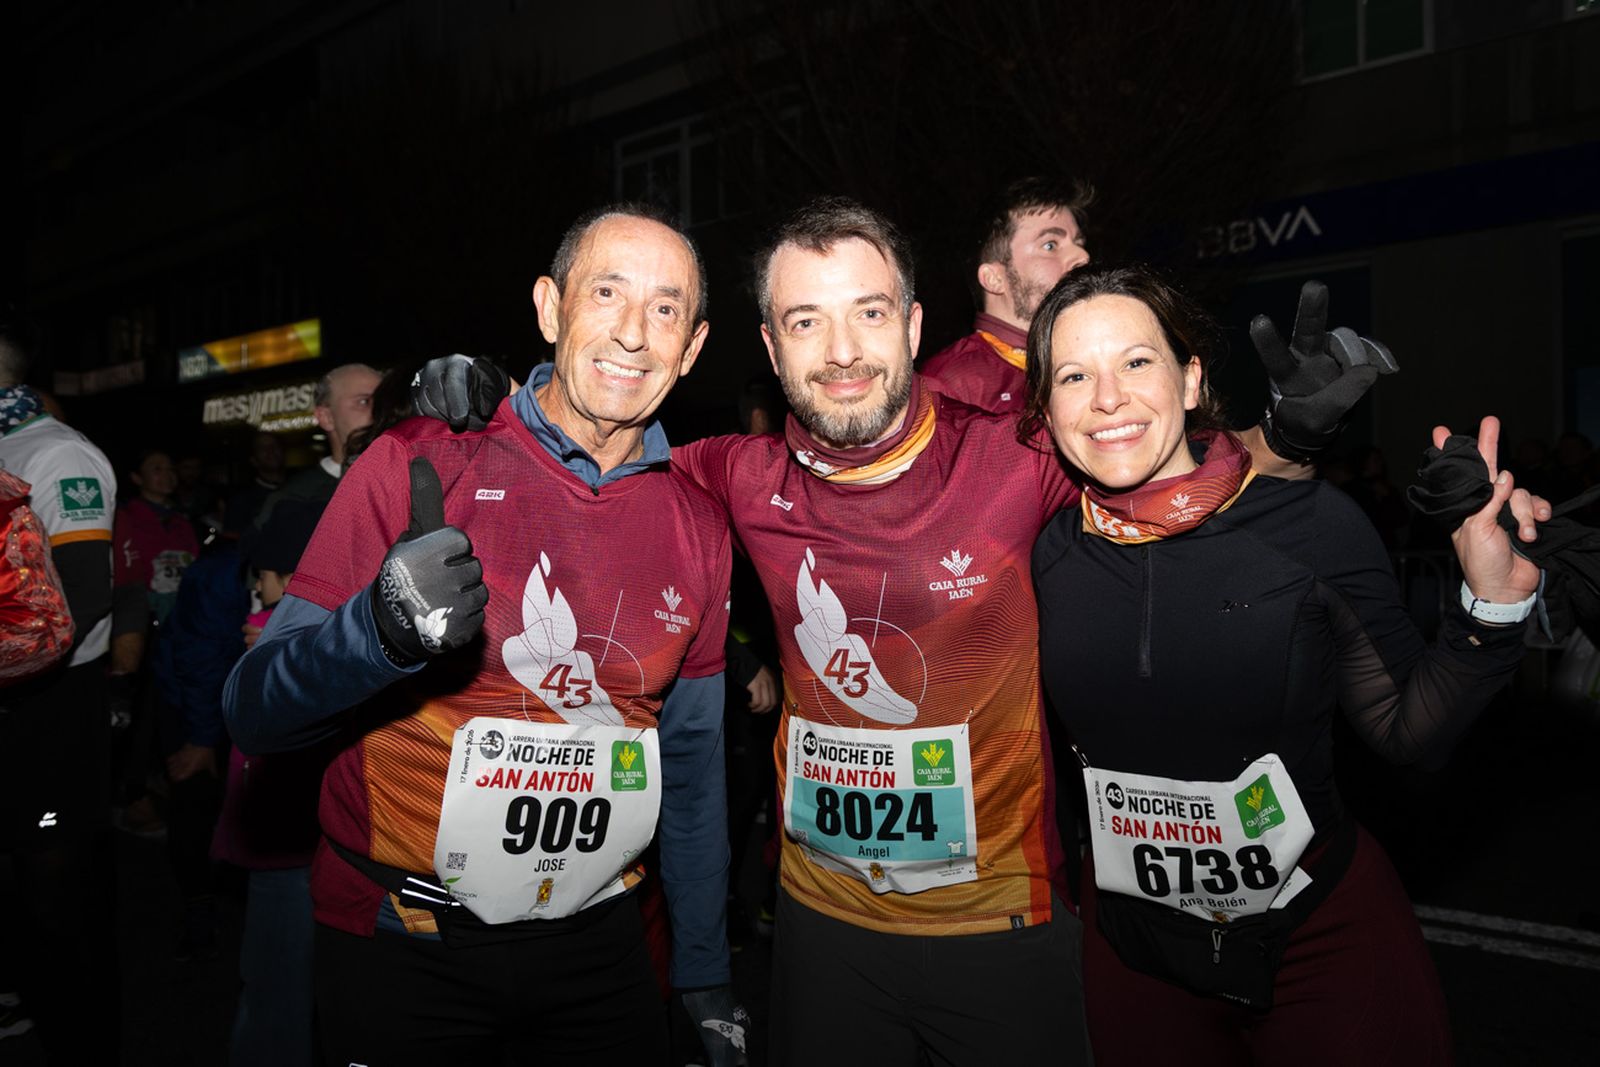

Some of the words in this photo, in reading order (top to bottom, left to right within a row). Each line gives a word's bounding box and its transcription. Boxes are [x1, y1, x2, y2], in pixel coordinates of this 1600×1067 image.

[929, 580, 954, 590] CAJA
[956, 575, 988, 587] RURAL
[824, 649, 870, 698] 43
[539, 664, 592, 708] 43
[506, 743, 572, 766] NOCHE
[574, 748, 595, 766] DE
[803, 736, 817, 750] 43
[837, 739, 855, 748] URBANA
[855, 742, 893, 750] INTERNACIONAL
[818, 744, 869, 765] NOCHE
[873, 750, 894, 766] DE
[525, 767, 594, 793] ANTÓN
[803, 761, 832, 783] SAN
[835, 766, 896, 789] ANTÓN
[1107, 788, 1123, 803] 43
[1126, 787, 1148, 796] CARRERA
[1148, 790, 1169, 798] URBANA
[1169, 792, 1212, 802] INTERNACIONAL
[815, 786, 939, 842] 8024
[1128, 795, 1187, 819] NOCHE
[1189, 803, 1216, 820] DE
[502, 795, 612, 855] 909
[1112, 815, 1147, 839] SAN
[1152, 820, 1222, 844] ANTÓN
[858, 845, 890, 859] Angel
[534, 858, 566, 873] JOSE
[1133, 843, 1280, 897] 6738
[1179, 896, 1203, 909] Ana
[1207, 896, 1247, 909] Belén
